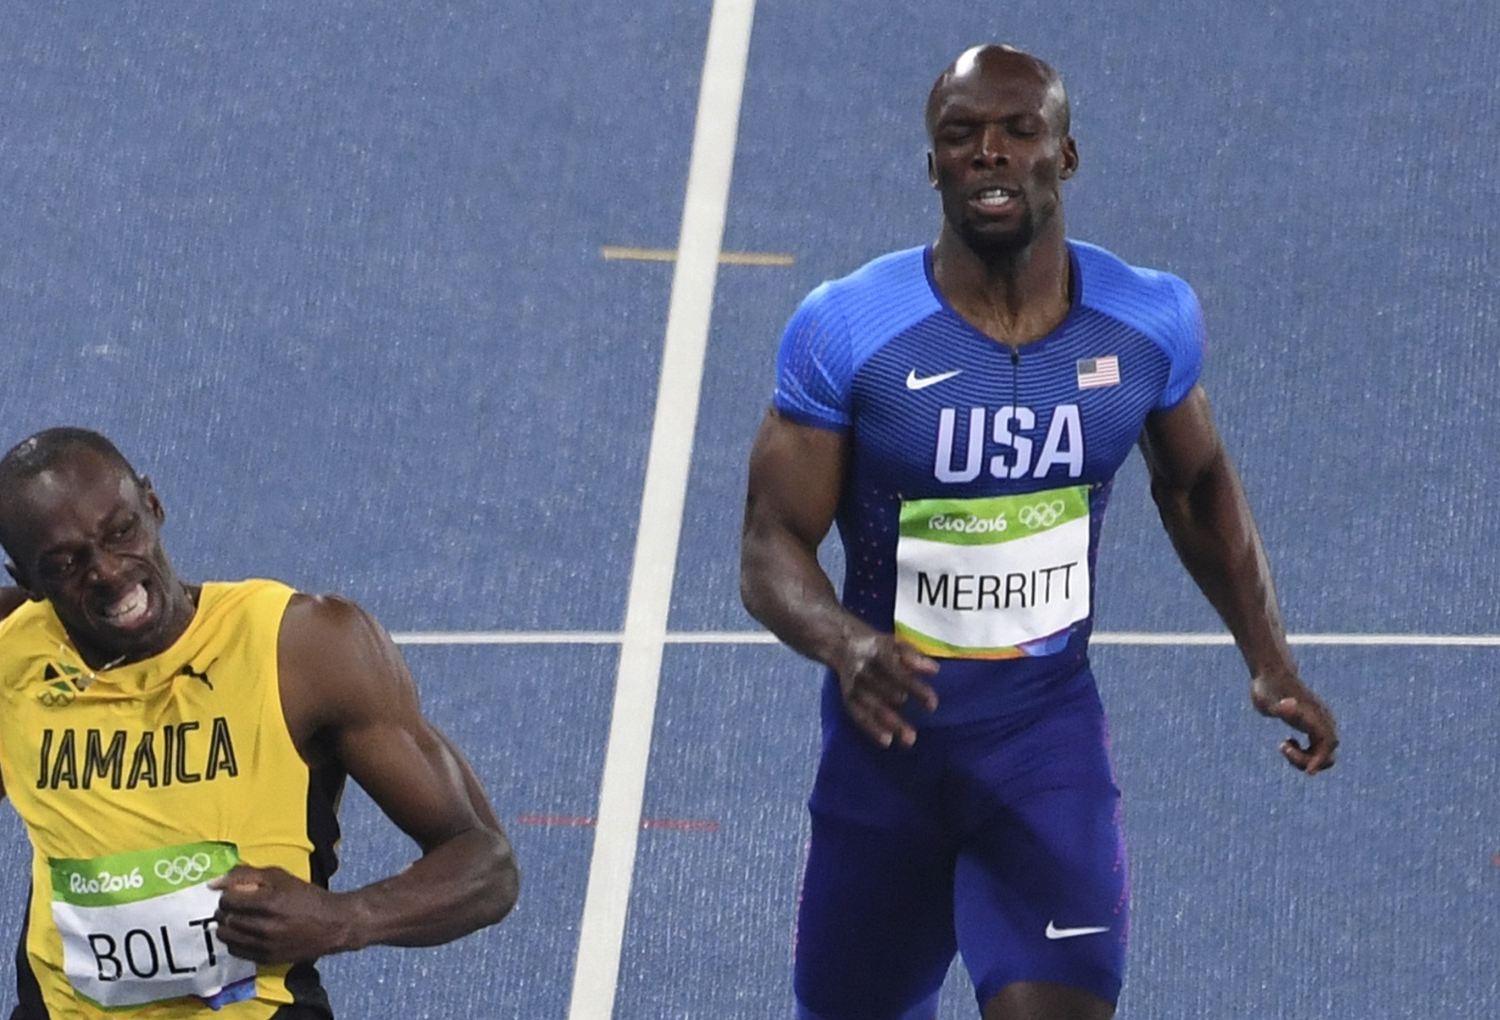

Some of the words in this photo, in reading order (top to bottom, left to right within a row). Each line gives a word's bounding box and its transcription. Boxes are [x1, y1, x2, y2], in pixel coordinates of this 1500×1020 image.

[934, 404, 1085, 483] USA
[928, 512, 1008, 534] Rio2016
[917, 562, 1078, 612] MERRITT
[36, 716, 239, 790] JAMAICA
[70, 868, 144, 894] Rio2016
[88, 917, 220, 982] BOLT
